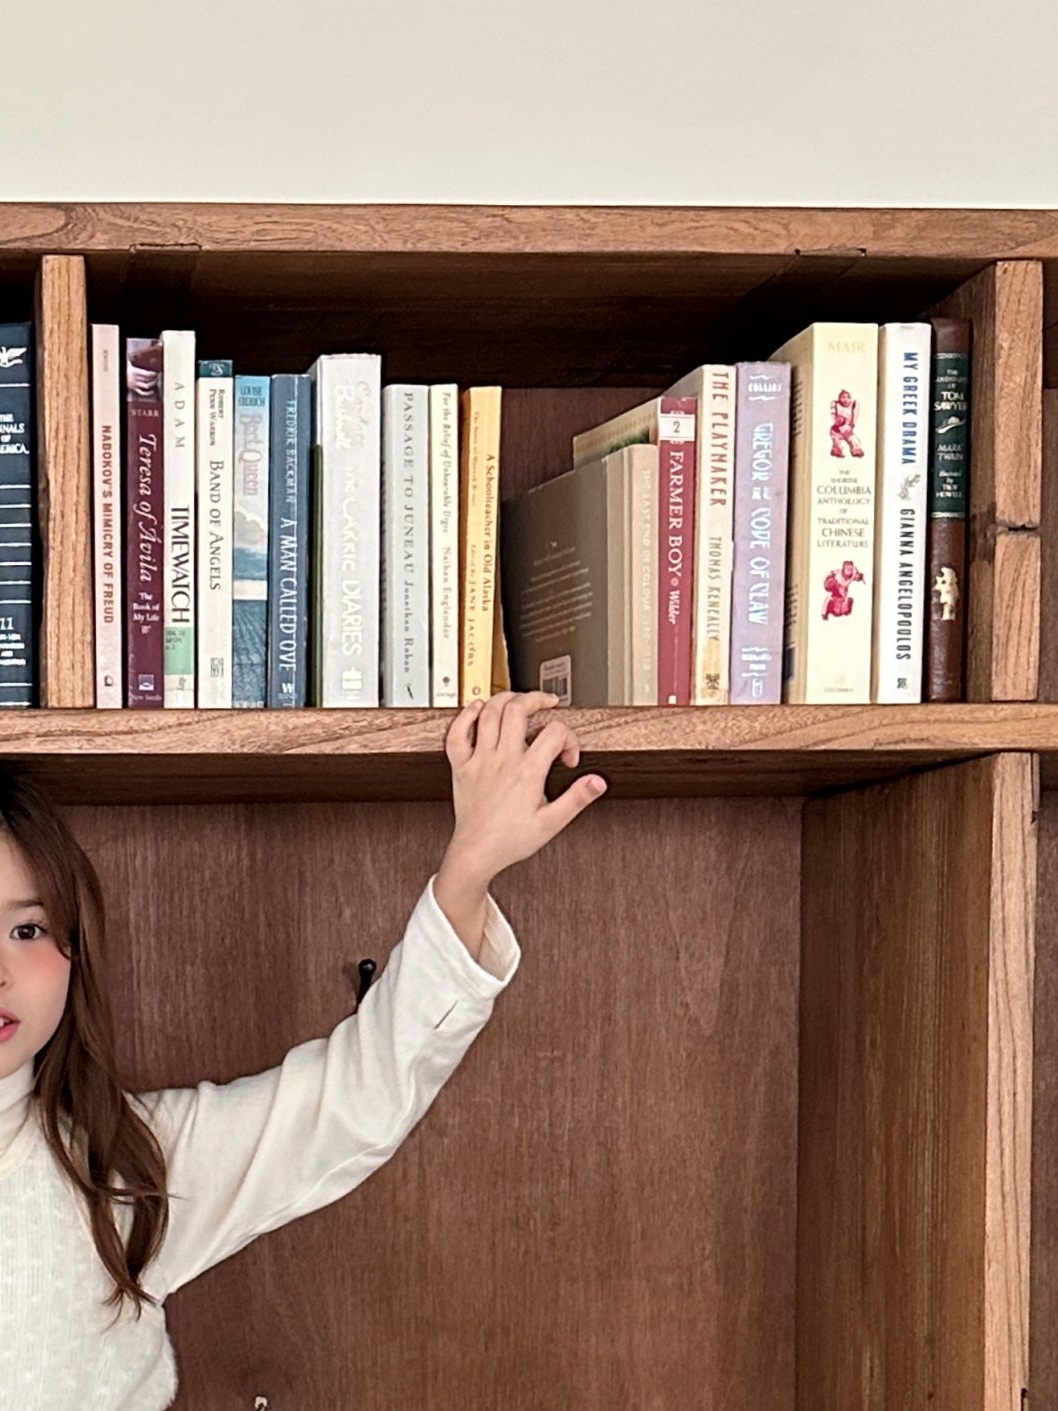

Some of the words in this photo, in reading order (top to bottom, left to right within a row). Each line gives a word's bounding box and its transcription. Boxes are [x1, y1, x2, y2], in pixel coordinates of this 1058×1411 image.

[903, 352, 919, 371] MY
[712, 371, 730, 401] THE
[902, 376, 919, 416] GREEK
[940, 391, 965, 400] TOM
[130, 409, 160, 418] STARR
[284, 400, 298, 445] FREDRIK
[403, 391, 414, 469] PASSAGE
[672, 420, 681, 434] 2
[101, 425, 113, 499] NABOKOV'S
[485, 453, 496, 462] A
[710, 411, 729, 506] PLAYMAKER
[901, 422, 918, 465] DRAMA
[138, 433, 157, 496] Teresa
[209, 459, 225, 504] BAND
[239, 449, 263, 496] Queen
[284, 449, 298, 503] BACKMAN
[403, 475, 414, 498] TO
[483, 465, 496, 536] Schoolteacher
[668, 451, 684, 530] FARMER
[816, 485, 872, 495] COLUMBIA
[817, 497, 871, 506] ANTHOLOGY
[102, 502, 114, 559] MIMICRY
[132, 500, 158, 527] of
[209, 507, 221, 528] OF
[280, 517, 297, 529] A
[816, 517, 870, 526] TRADITIONAL
[821, 527, 866, 538] CHINESE
[898, 508, 916, 556] GIANNA
[280, 534, 298, 572] MAN
[403, 504, 415, 574] JUNEAU
[667, 535, 683, 578] BOY
[707, 536, 722, 580] THOMAS
[816, 539, 869, 548] LITERATURE
[102, 562, 114, 579] OF
[171, 504, 191, 624] TIMEWATCH
[209, 532, 224, 591] ANGELS
[483, 553, 493, 574] Old
[103, 583, 115, 624] FREUD
[279, 577, 298, 634] CALLED
[403, 580, 414, 632] Jonathan
[482, 577, 492, 612] Alaska
[668, 589, 681, 625] Wilder
[706, 586, 721, 642] KENEALLY
[895, 562, 914, 661] ANGELOPOULOS
[342, 580, 363, 656] DIARIES
[278, 639, 297, 672] OVE
[403, 637, 414, 673] Raban
